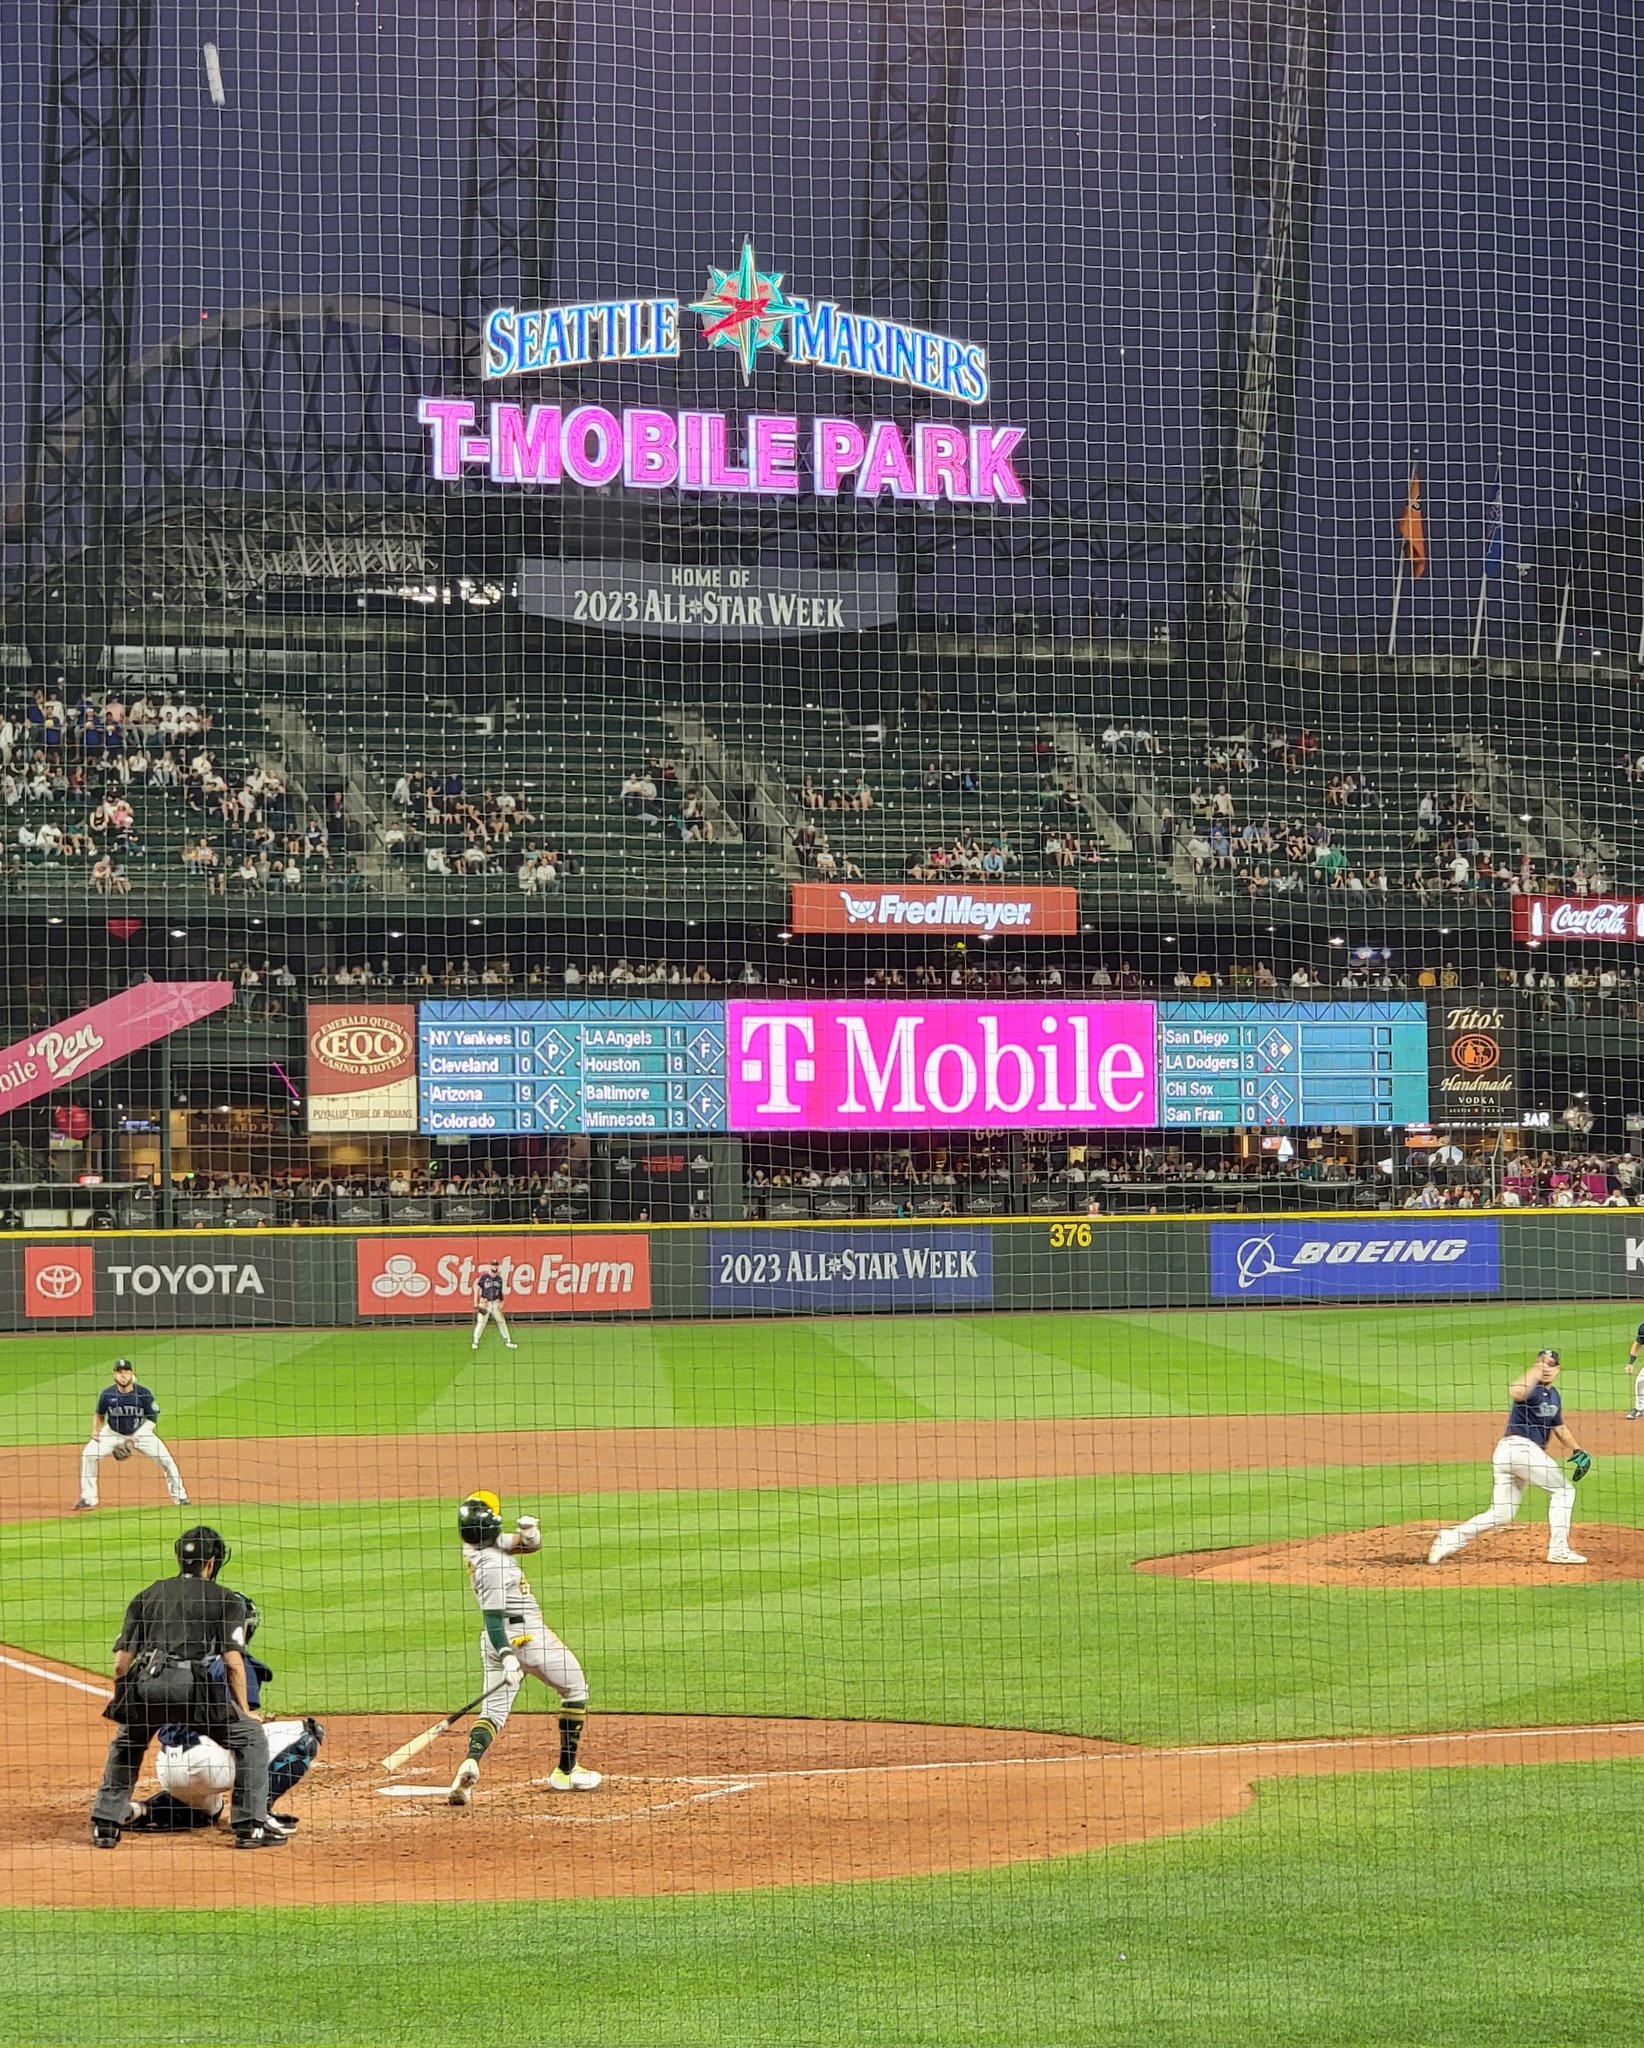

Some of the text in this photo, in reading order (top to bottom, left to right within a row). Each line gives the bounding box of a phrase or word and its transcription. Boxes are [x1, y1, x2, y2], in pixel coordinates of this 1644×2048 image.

[482, 297, 988, 405] SEATTLE MARINERS
[418, 397, 1027, 504] T-MOBILE PARK
[671, 567, 751, 588] HOME OF
[573, 589, 638, 623] 2023
[767, 592, 845, 628] WEEK
[319, 1015, 404, 1036] EMERALD QUEEN
[1446, 1007, 1505, 1030] Tito's
[331, 1031, 397, 1062] EQC
[430, 1030, 530, 1046] NY Yankees 0
[585, 1030, 681, 1048] LA Angels 1
[1166, 1029, 1252, 1047] San Diego 1
[547, 1043, 559, 1060] P
[701, 1043, 711, 1059] F
[1270, 1042, 1279, 1058] 8
[319, 1055, 406, 1075] CASINO & HOTEL
[431, 1057, 531, 1073] Cleveland 0
[585, 1056, 683, 1072] Houston 8
[835, 1015, 1146, 1115] Mobile
[1166, 1054, 1254, 1072] LA Dodgers 3
[1166, 1081, 1255, 1097] Chi Sox 0
[1440, 1073, 1513, 1092] Handmade
[432, 1085, 531, 1102] Arizona 9
[586, 1085, 683, 1100] Baltimore 2
[1458, 1096, 1495, 1105] VODKA
[549, 1098, 560, 1115] F
[701, 1097, 711, 1114] F
[1270, 1094, 1280, 1110] 8
[312, 1108, 413, 1119] PUYALLUP TRIBE OF INDIANS
[432, 1112, 531, 1129] Colorado 3
[586, 1111, 684, 1128] Minnesota 3
[1167, 1106, 1255, 1122] San Fran 0
[1050, 1223, 1092, 1248] 376
[1291, 1239, 1468, 1265] BOEING
[720, 1253, 781, 1284] 2023
[903, 1247, 979, 1280] WEEK
[107, 1263, 265, 1297] TOYOTA
